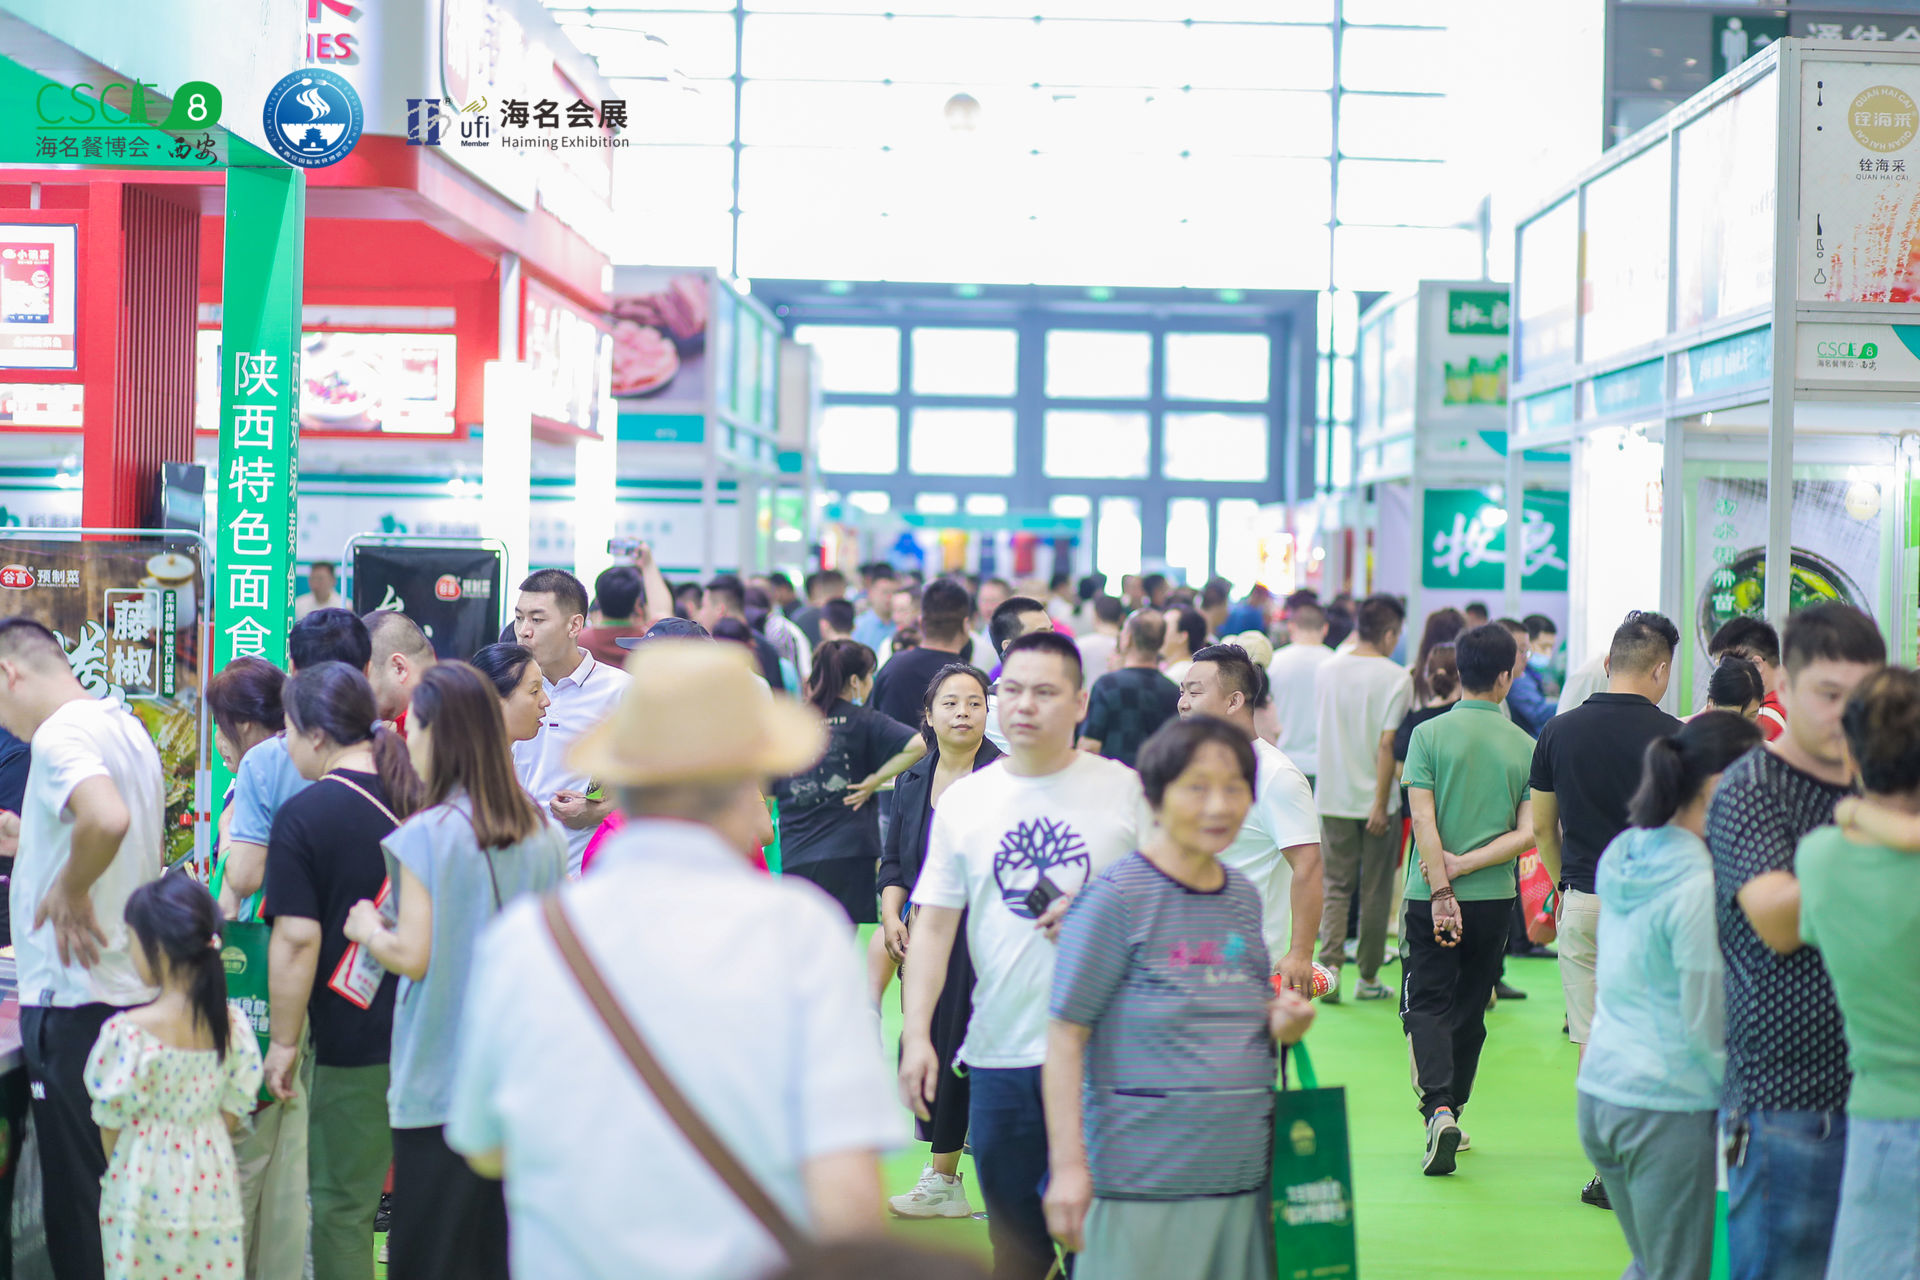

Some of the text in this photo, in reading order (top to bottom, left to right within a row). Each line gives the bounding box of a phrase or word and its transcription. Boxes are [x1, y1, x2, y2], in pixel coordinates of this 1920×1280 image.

[1855, 88, 1880, 108] QUAN
[1881, 88, 1898, 98] HAI
[1859, 158, 1906, 173] 铨海采
[224, 349, 279, 662] 陕西特色面食
[37, 569, 80, 584] 预制菜
[112, 599, 153, 687] 藤椒
